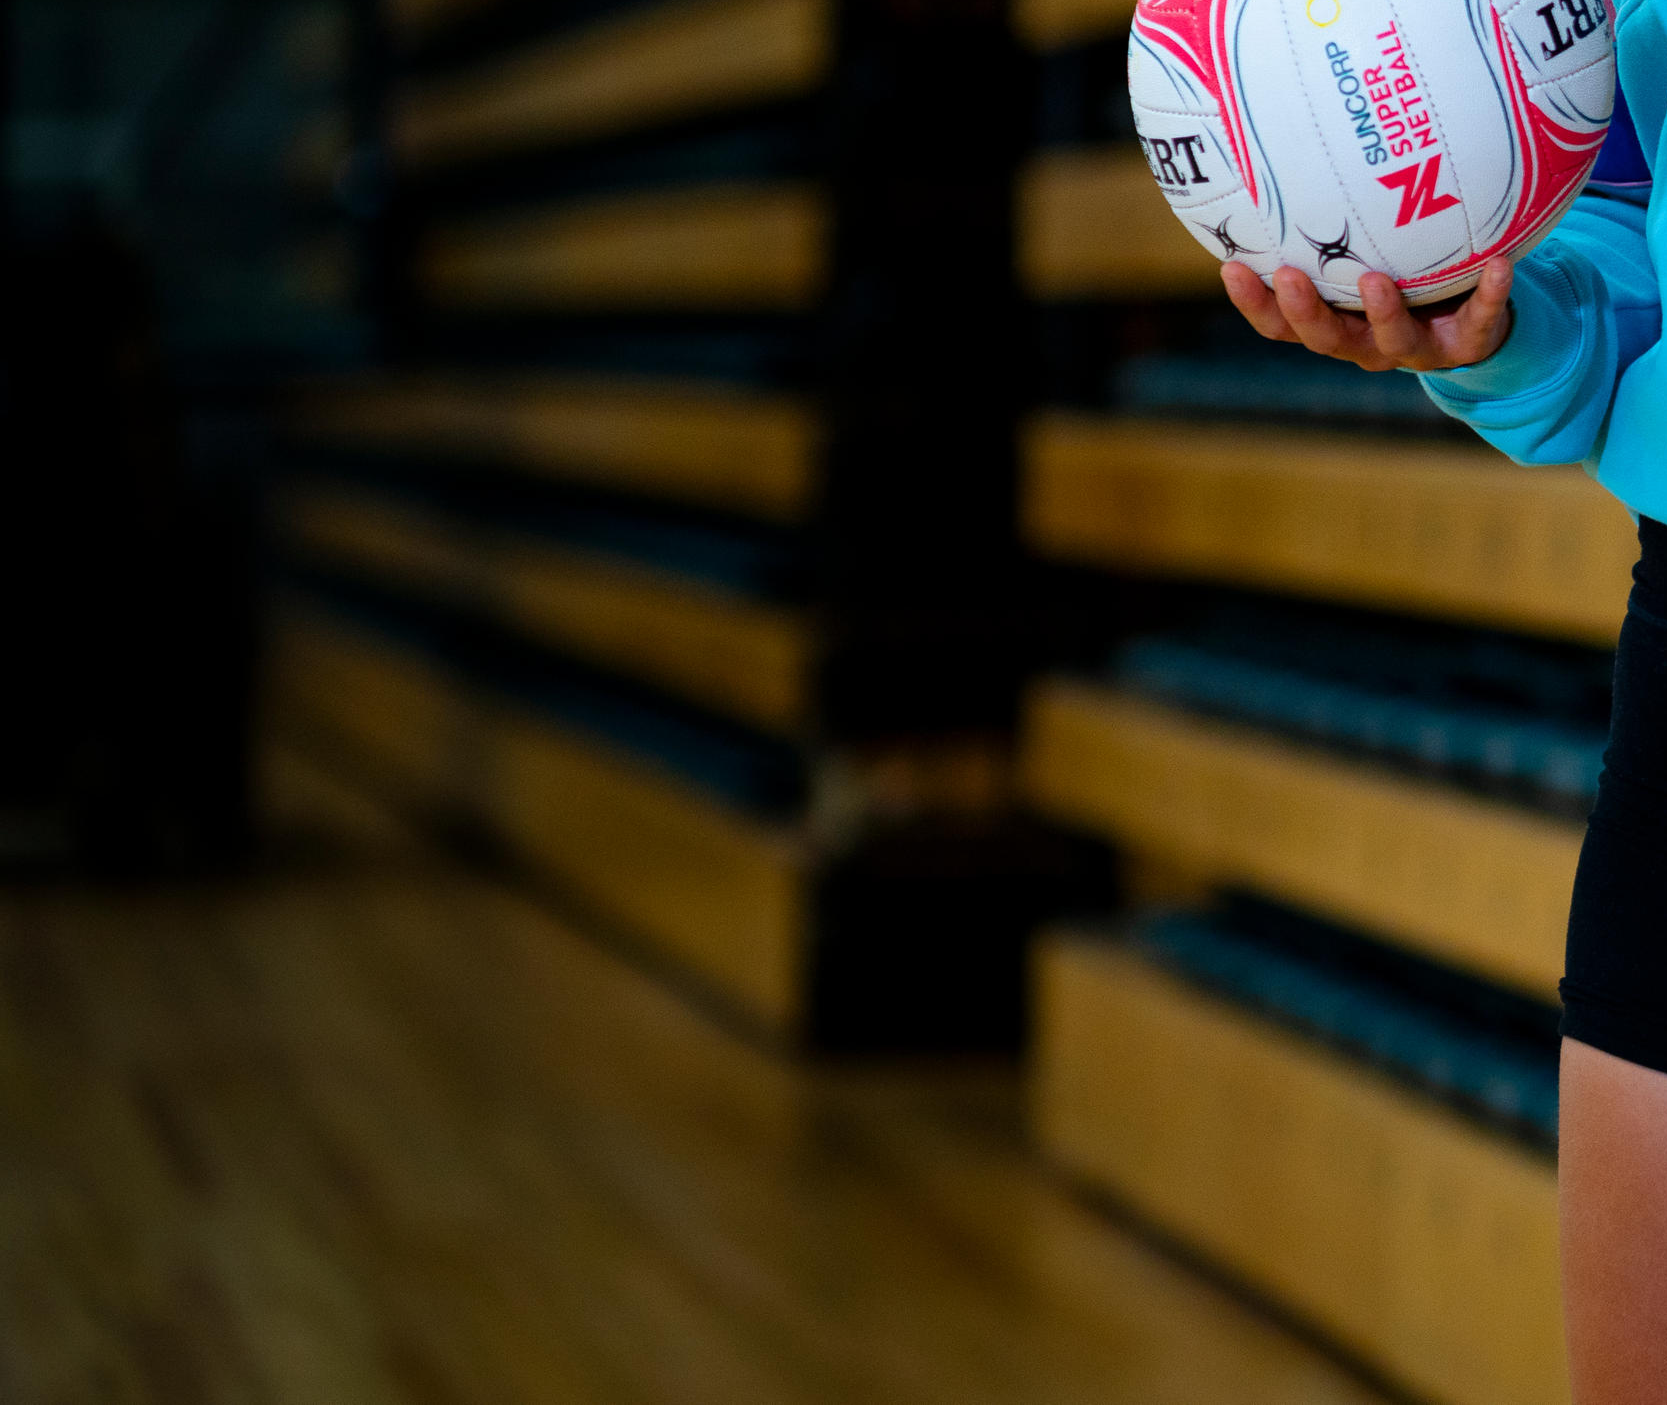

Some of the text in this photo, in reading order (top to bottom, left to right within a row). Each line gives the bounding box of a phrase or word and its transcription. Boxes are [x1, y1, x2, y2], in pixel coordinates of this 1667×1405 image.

[1324, 40, 1389, 167] SUNCORP
[1362, 63, 1414, 158] SUPER
[1375, 19, 1439, 151] NETBALL
